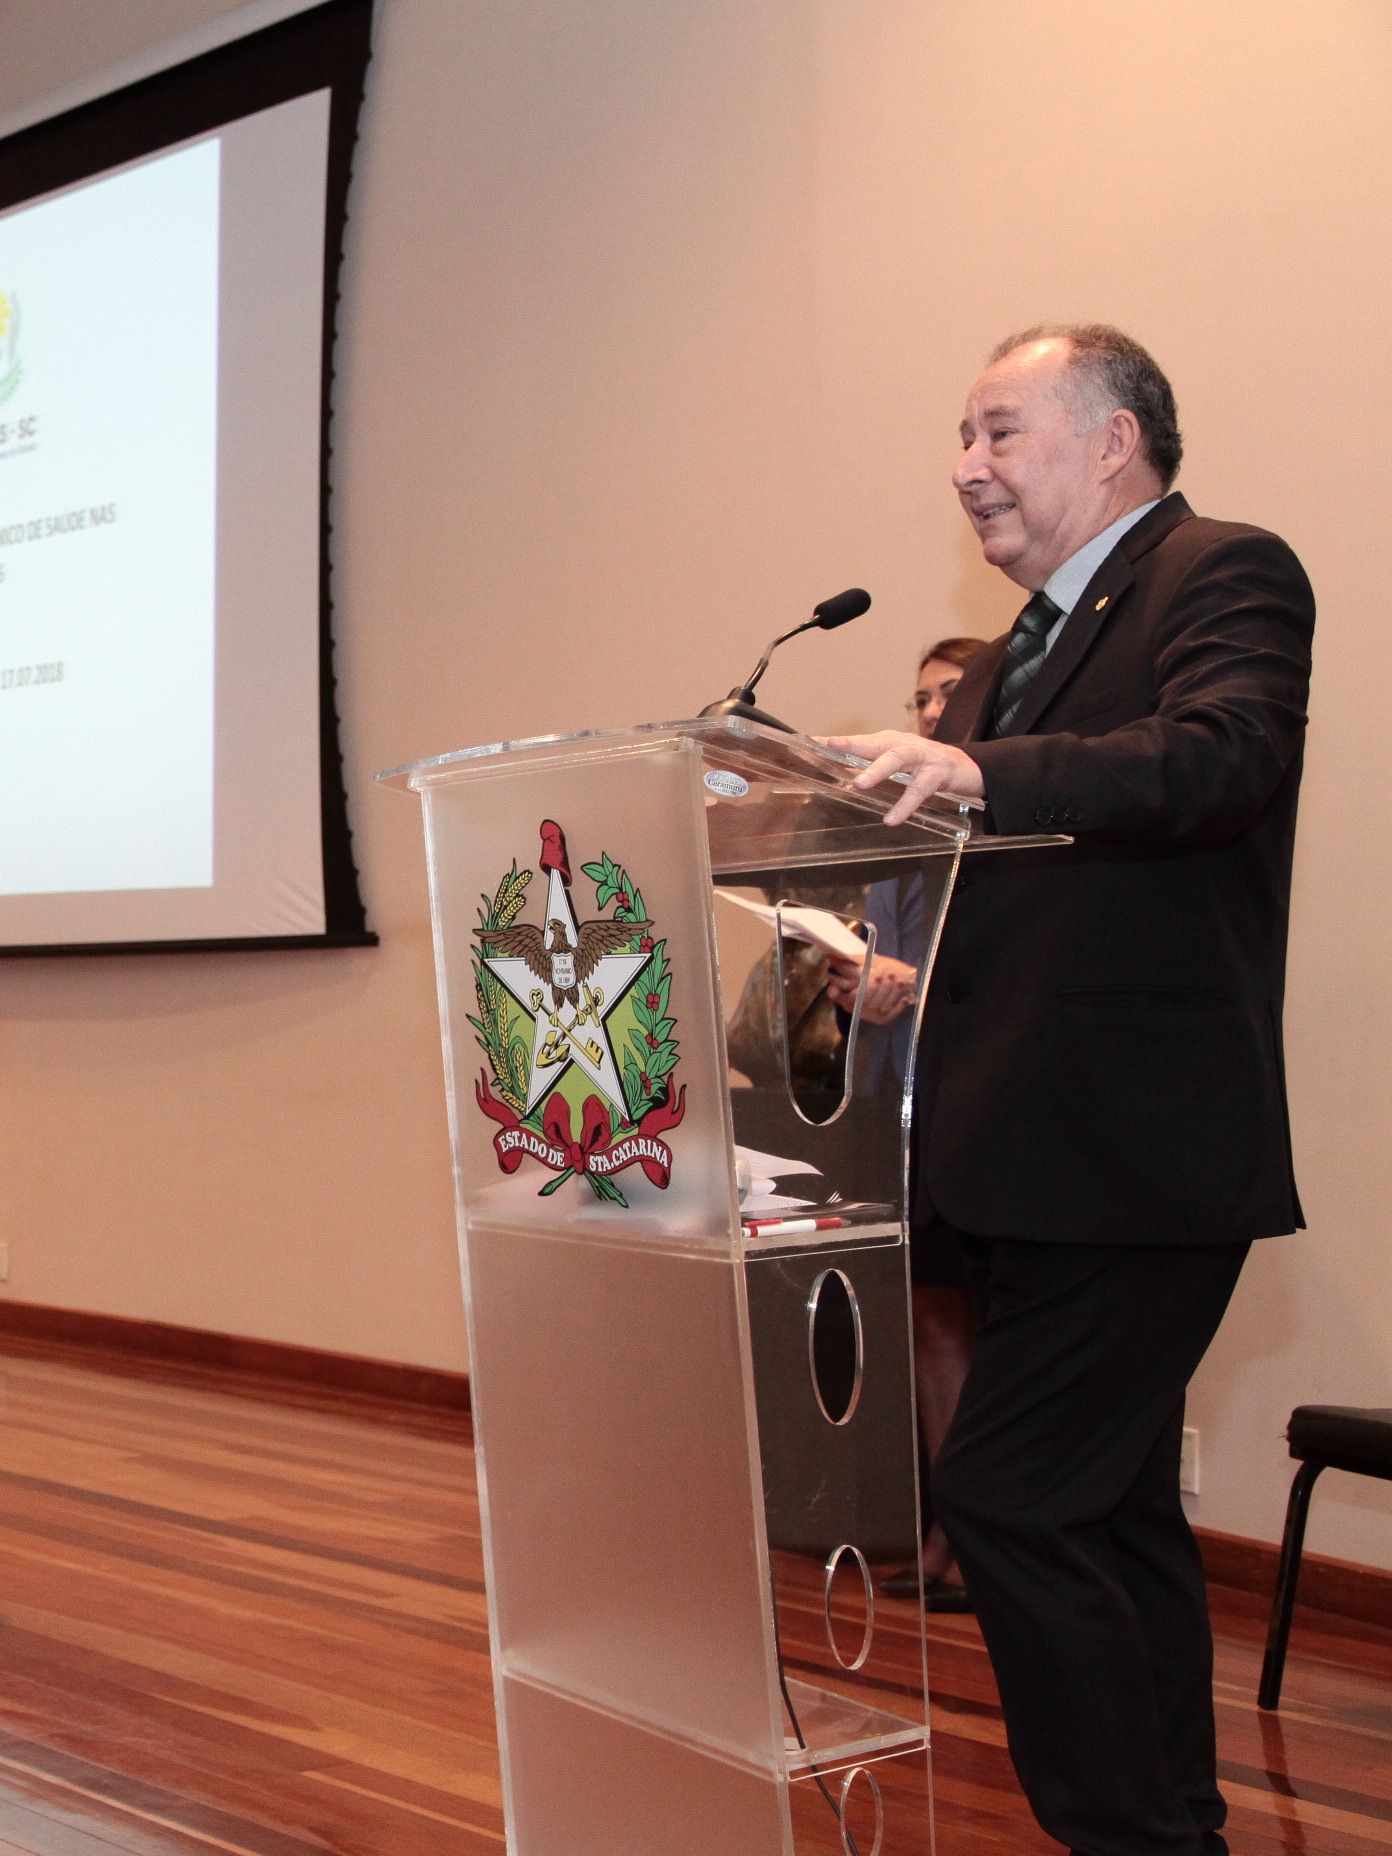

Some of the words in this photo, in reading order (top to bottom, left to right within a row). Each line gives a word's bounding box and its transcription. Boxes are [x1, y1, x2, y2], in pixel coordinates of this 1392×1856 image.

[18, 415, 37, 439] SC
[27, 518, 44, 542] DE
[45, 508, 87, 537] SAÚDE
[89, 502, 116, 527] NAS
[498, 1131, 547, 1158] ESTADO
[547, 1149, 565, 1167] DE
